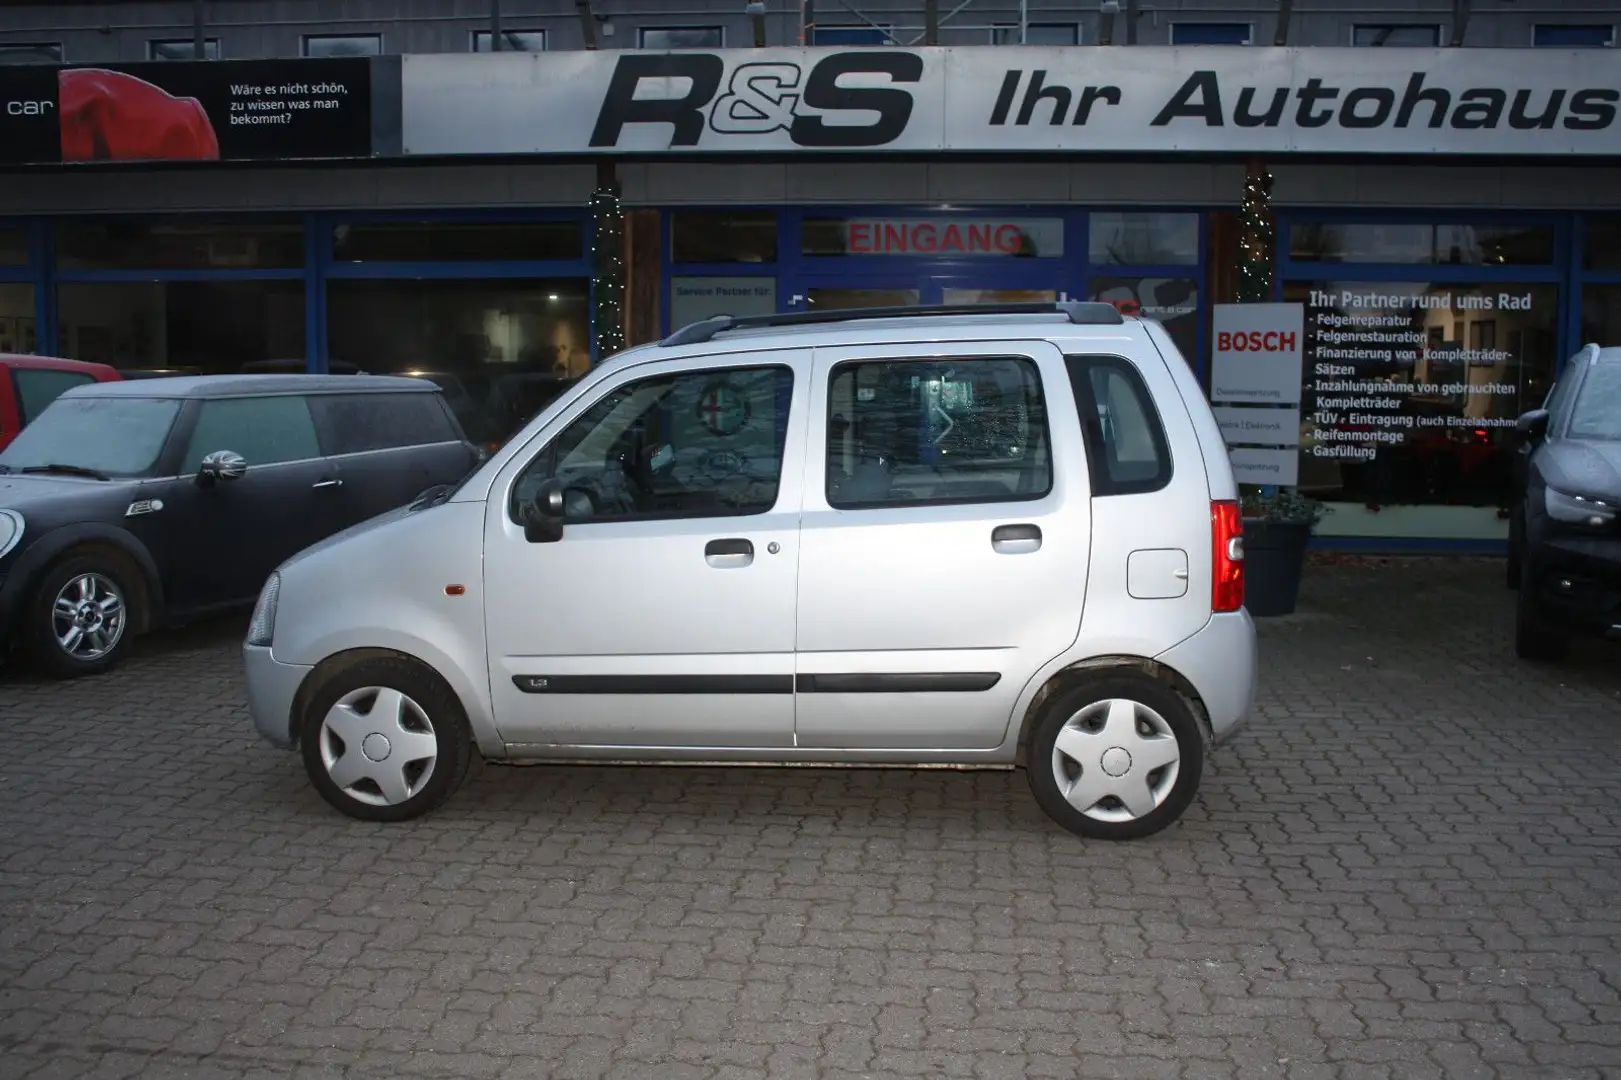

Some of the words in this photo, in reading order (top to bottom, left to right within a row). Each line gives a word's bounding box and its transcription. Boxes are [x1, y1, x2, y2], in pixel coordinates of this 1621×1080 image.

[230, 83, 261, 96] Wäre
[264, 86, 277, 95] es
[279, 83, 308, 95] nicht
[311, 83, 348, 97] schön,
[230, 101, 243, 111] zu
[246, 98, 285, 111] wissen
[288, 100, 310, 110] was
[313, 100, 339, 109] man
[589, 51, 924, 147] R&S
[987, 69, 1121, 126] Ihr
[1149, 70, 1620, 130] Autohaus
[7, 100, 54, 115] car
[230, 111, 292, 125] bekommt?
[849, 222, 1024, 254] EINGANG
[716, 286, 752, 296] Partner
[1309, 290, 1335, 309] Ihr
[1341, 291, 1408, 309] Partner
[1411, 292, 1451, 310] rund
[1457, 296, 1493, 310] ums
[1498, 293, 1532, 310] Rad
[1316, 313, 1412, 328] Felgenreparatur
[1217, 331, 1296, 352] BOSCH
[1316, 329, 1428, 345] Felgenrestauration
[1315, 346, 1392, 362] Finanzierung
[1395, 350, 1417, 361] von
[1422, 348, 1513, 363] Kompletträder-
[1315, 363, 1355, 376] Sätzen
[1315, 379, 1414, 395] Inzahlungnahme
[1417, 383, 1439, 393] von
[1441, 381, 1516, 396] gebrauchten
[1316, 396, 1402, 411] Kompletträder
[1313, 411, 1339, 425] TÜV
[1348, 413, 1414, 428] Eintragung
[1416, 415, 1444, 429] (auch
[1313, 429, 1405, 445] Reifenmontage
[1312, 445, 1377, 461] Gasfüllung
